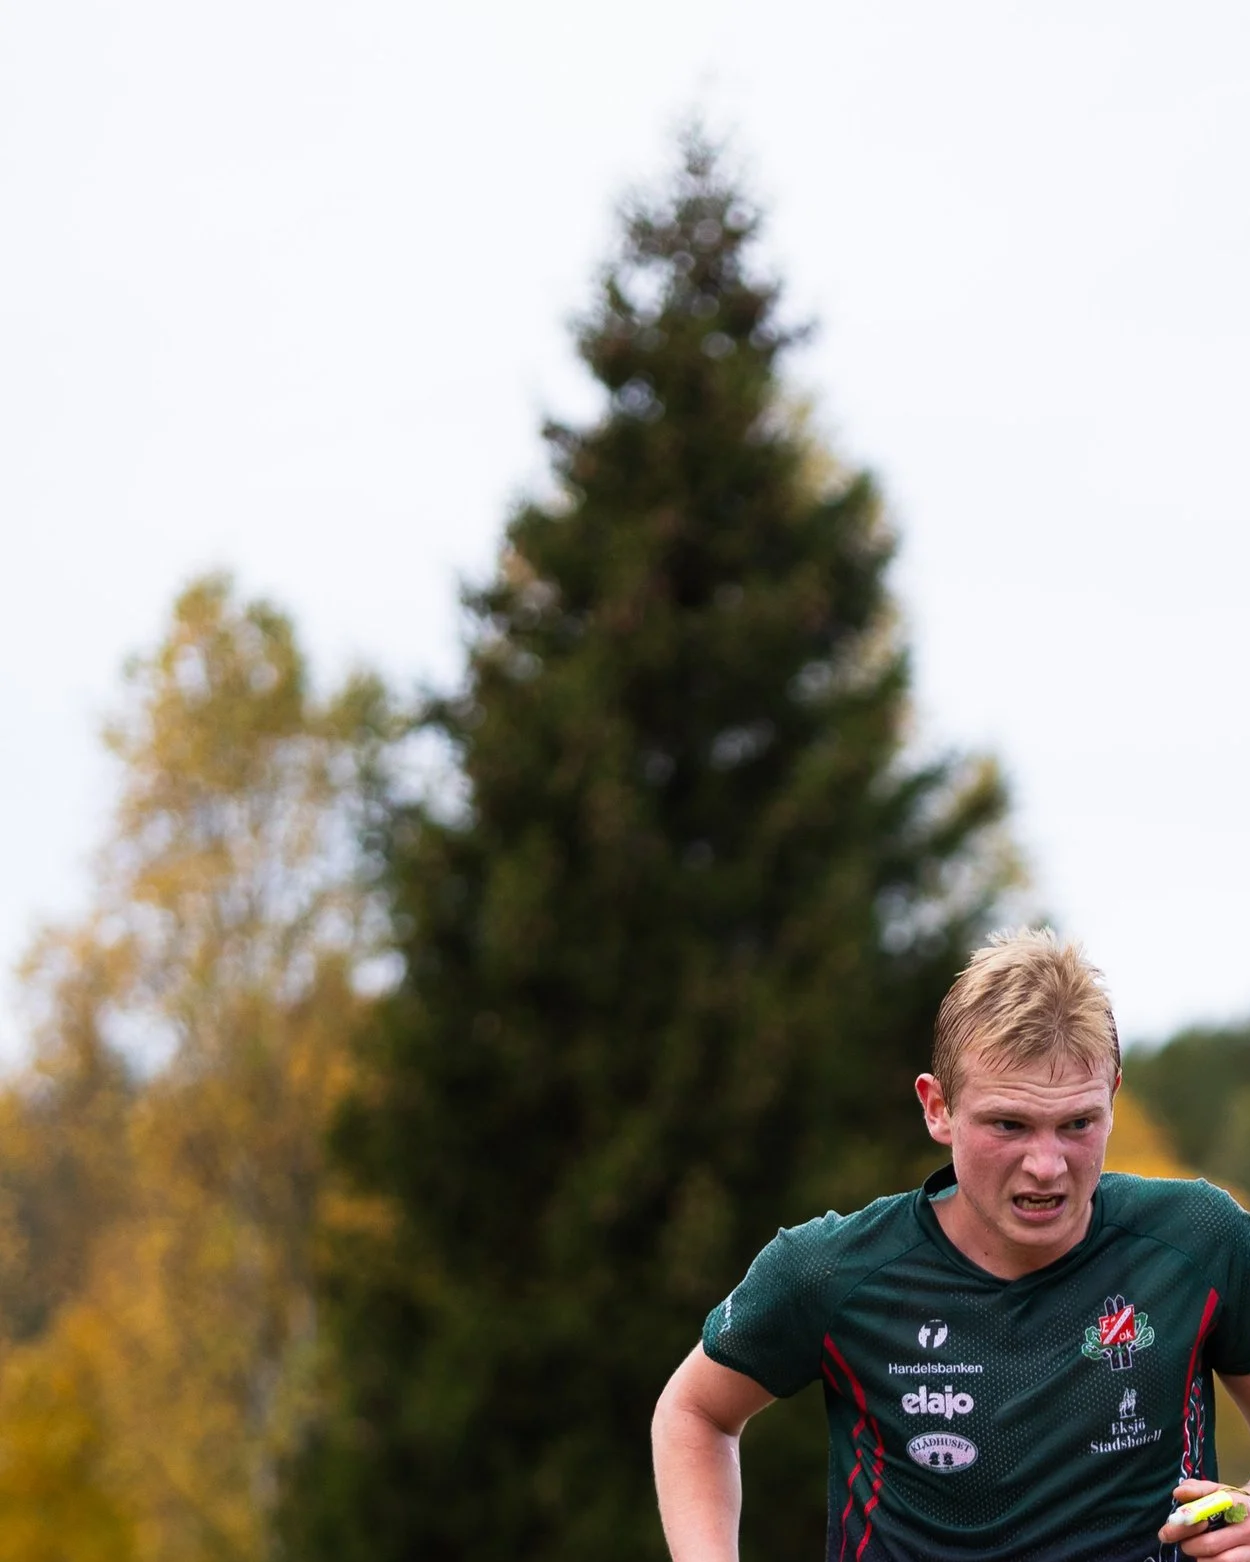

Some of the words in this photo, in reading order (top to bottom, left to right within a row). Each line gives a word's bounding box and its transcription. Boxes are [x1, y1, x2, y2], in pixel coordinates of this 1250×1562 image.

[888, 1362, 983, 1375] Handelsbanken
[901, 1384, 975, 1421] elajo
[1111, 1417, 1146, 1436] Eksjö
[1088, 1428, 1162, 1454] Stadshotell
